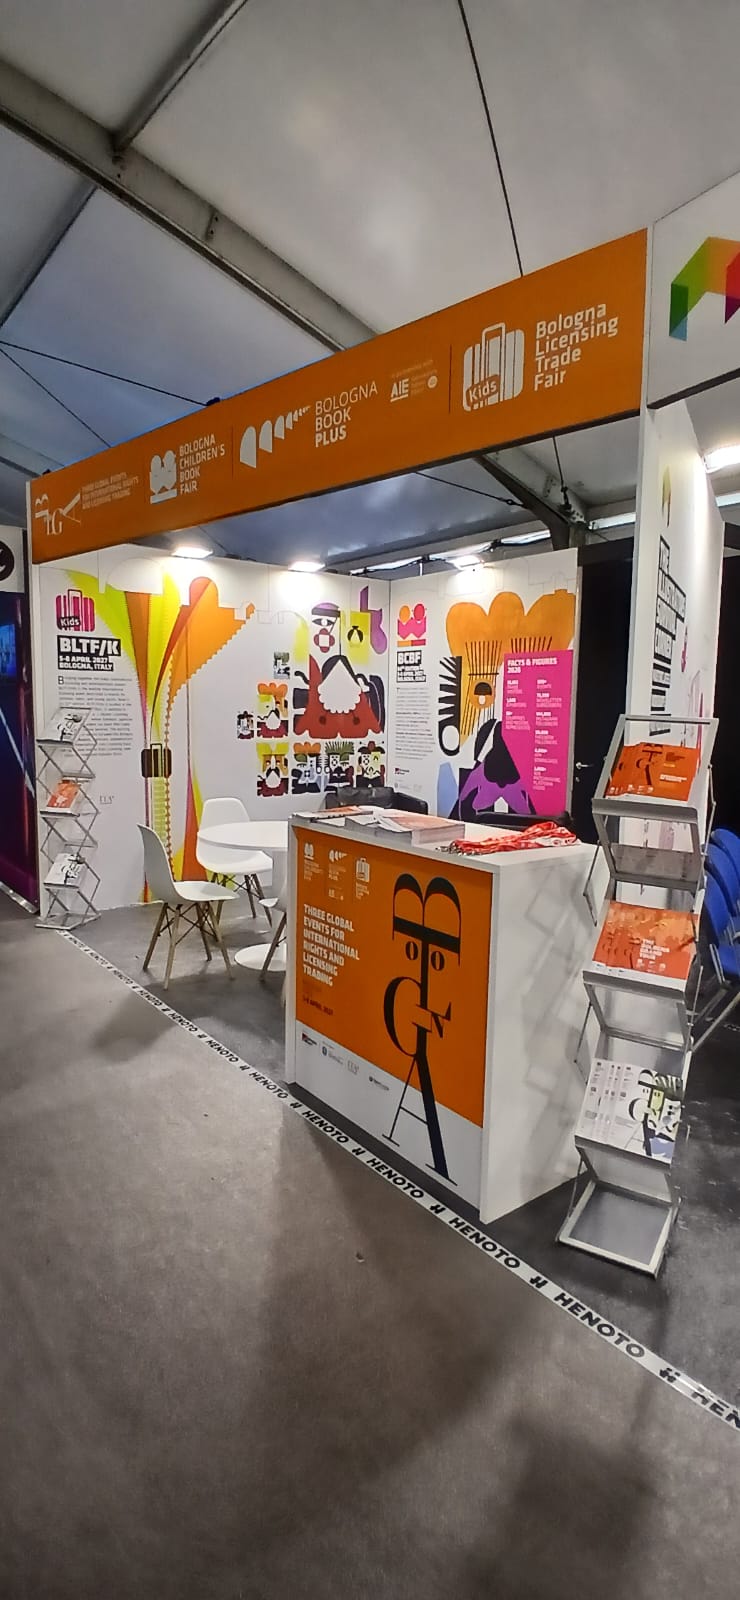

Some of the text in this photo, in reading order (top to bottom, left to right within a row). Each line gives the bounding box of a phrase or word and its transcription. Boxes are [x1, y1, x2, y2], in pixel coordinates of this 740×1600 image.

[536, 304, 606, 339] Bologna
[536, 317, 618, 357] Licensing
[535, 348, 581, 373] Trade
[390, 378, 409, 398] AIE
[469, 380, 497, 402] Kids
[534, 369, 567, 391] Fair
[315, 381, 378, 416] BOLOGNA
[315, 406, 351, 432] BOOK
[180, 433, 216, 456] BOLOGNA
[315, 425, 347, 448] PLUS
[180, 443, 225, 469] CHILDREN'S
[180, 466, 200, 482] BOOK
[180, 480, 197, 495] FAIR
[60, 618, 80, 627] Kids
[60, 638, 119, 656] BLTF/K
[304, 904, 354, 932] THREE GLOBAL
[304, 916, 345, 941] EVENTS FOR
[304, 929, 360, 960] INTERNATIONAL
[304, 940, 345, 967] RIGHTS AND
[303, 952, 338, 976] LICENSING
[303, 964, 333, 986] TRADING
[206, 1039, 239, 1063] HENOTO
[249, 1071, 288, 1099] HENOTO
[302, 1110, 349, 1143] HENOTO
[366, 1158, 424, 1199] HENOTO
[449, 1217, 520, 1268] HENOTO
[554, 1292, 645, 1358] HENOTO
